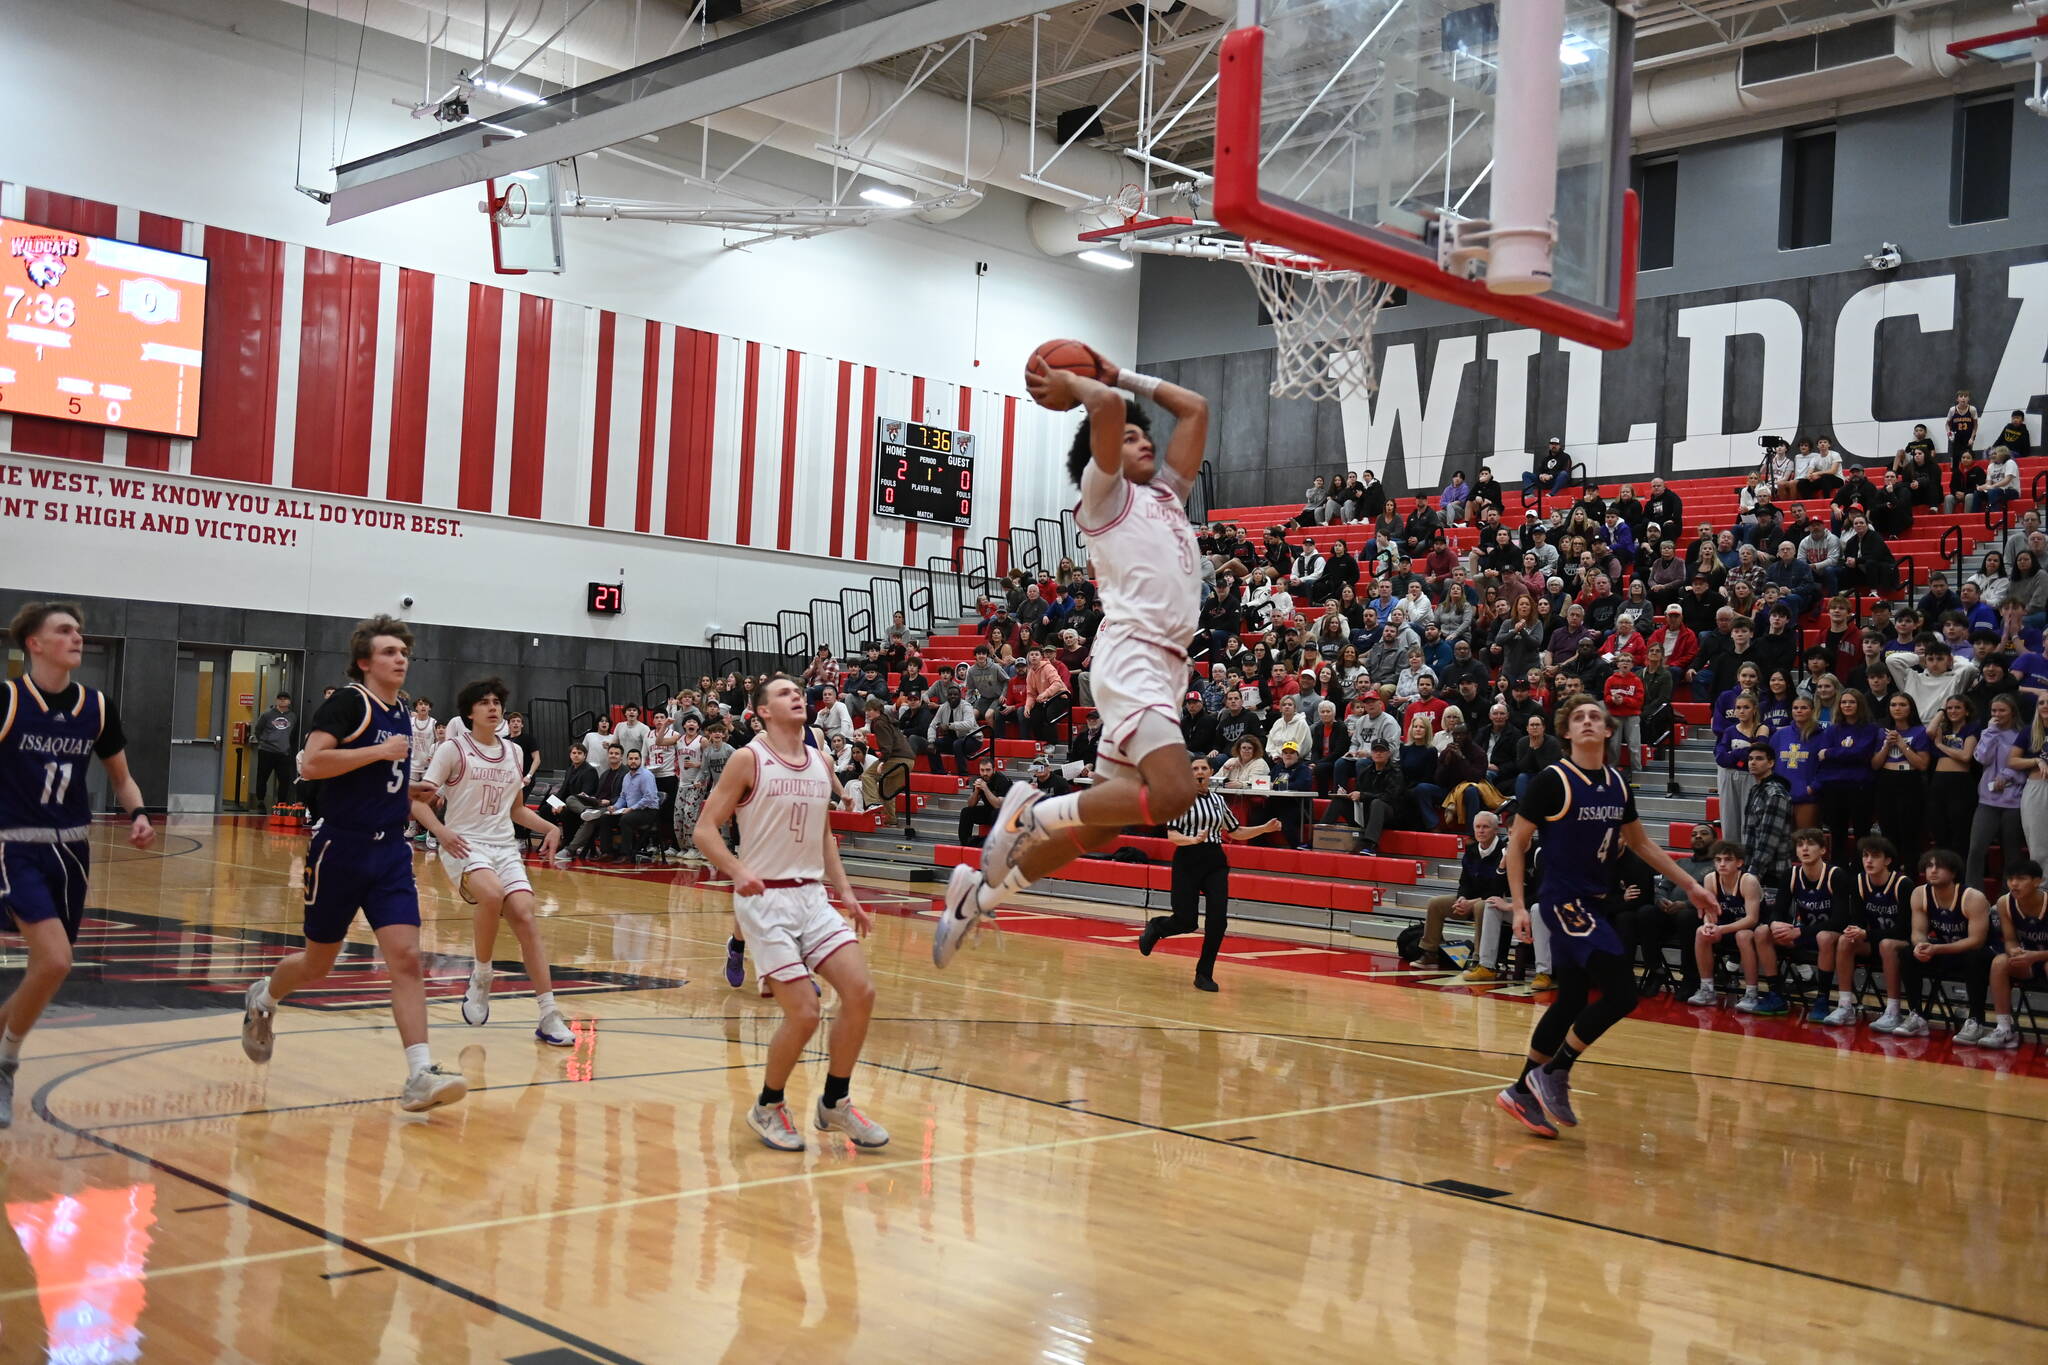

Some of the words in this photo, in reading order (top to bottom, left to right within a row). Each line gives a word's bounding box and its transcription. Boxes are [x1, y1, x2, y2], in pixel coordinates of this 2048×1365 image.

[11, 237, 80, 258] WILDCATS
[68, 397, 82, 415] 5
[106, 401, 122, 422] 0
[919, 427, 951, 451] 7:36
[886, 444, 907, 457] HOME
[897, 459, 908, 480] 2
[919, 456, 937, 465] PERIOD
[947, 455, 970, 468] GUEST
[880, 478, 897, 487] FOULS
[927, 467, 932, 481] 1
[960, 470, 970, 490] 0
[885, 487, 894, 503] 0
[911, 483, 930, 492] PLAYER
[930, 486, 942, 494] FOUL
[956, 490, 971, 499] FOULS
[29, 468, 102, 497] WEST,
[109, 477, 145, 500] WE
[151, 483, 222, 509] KNOW
[225, 492, 270, 515] YOU
[274, 499, 315, 520] ALL
[319, 503, 347, 523] DO
[352, 507, 405, 531] YOUR
[411, 515, 463, 538] BEST.
[879, 504, 895, 514] SCORE
[960, 499, 969, 515] 0
[0, 496, 39, 519] NT
[44, 501, 68, 522] SI
[75, 504, 136, 530] HIGH
[140, 512, 189, 535] AND
[195, 518, 297, 547] VICTORY!
[916, 510, 934, 519] MATCH
[954, 516, 970, 524] SCORE
[595, 586, 619, 609] 27
[655, 753, 664, 765] 15
[40, 761, 73, 805] 11
[386, 758, 405, 794] 5
[767, 779, 815, 798] MOUNT
[789, 802, 808, 843] 4
[1597, 827, 1613, 863] 4
